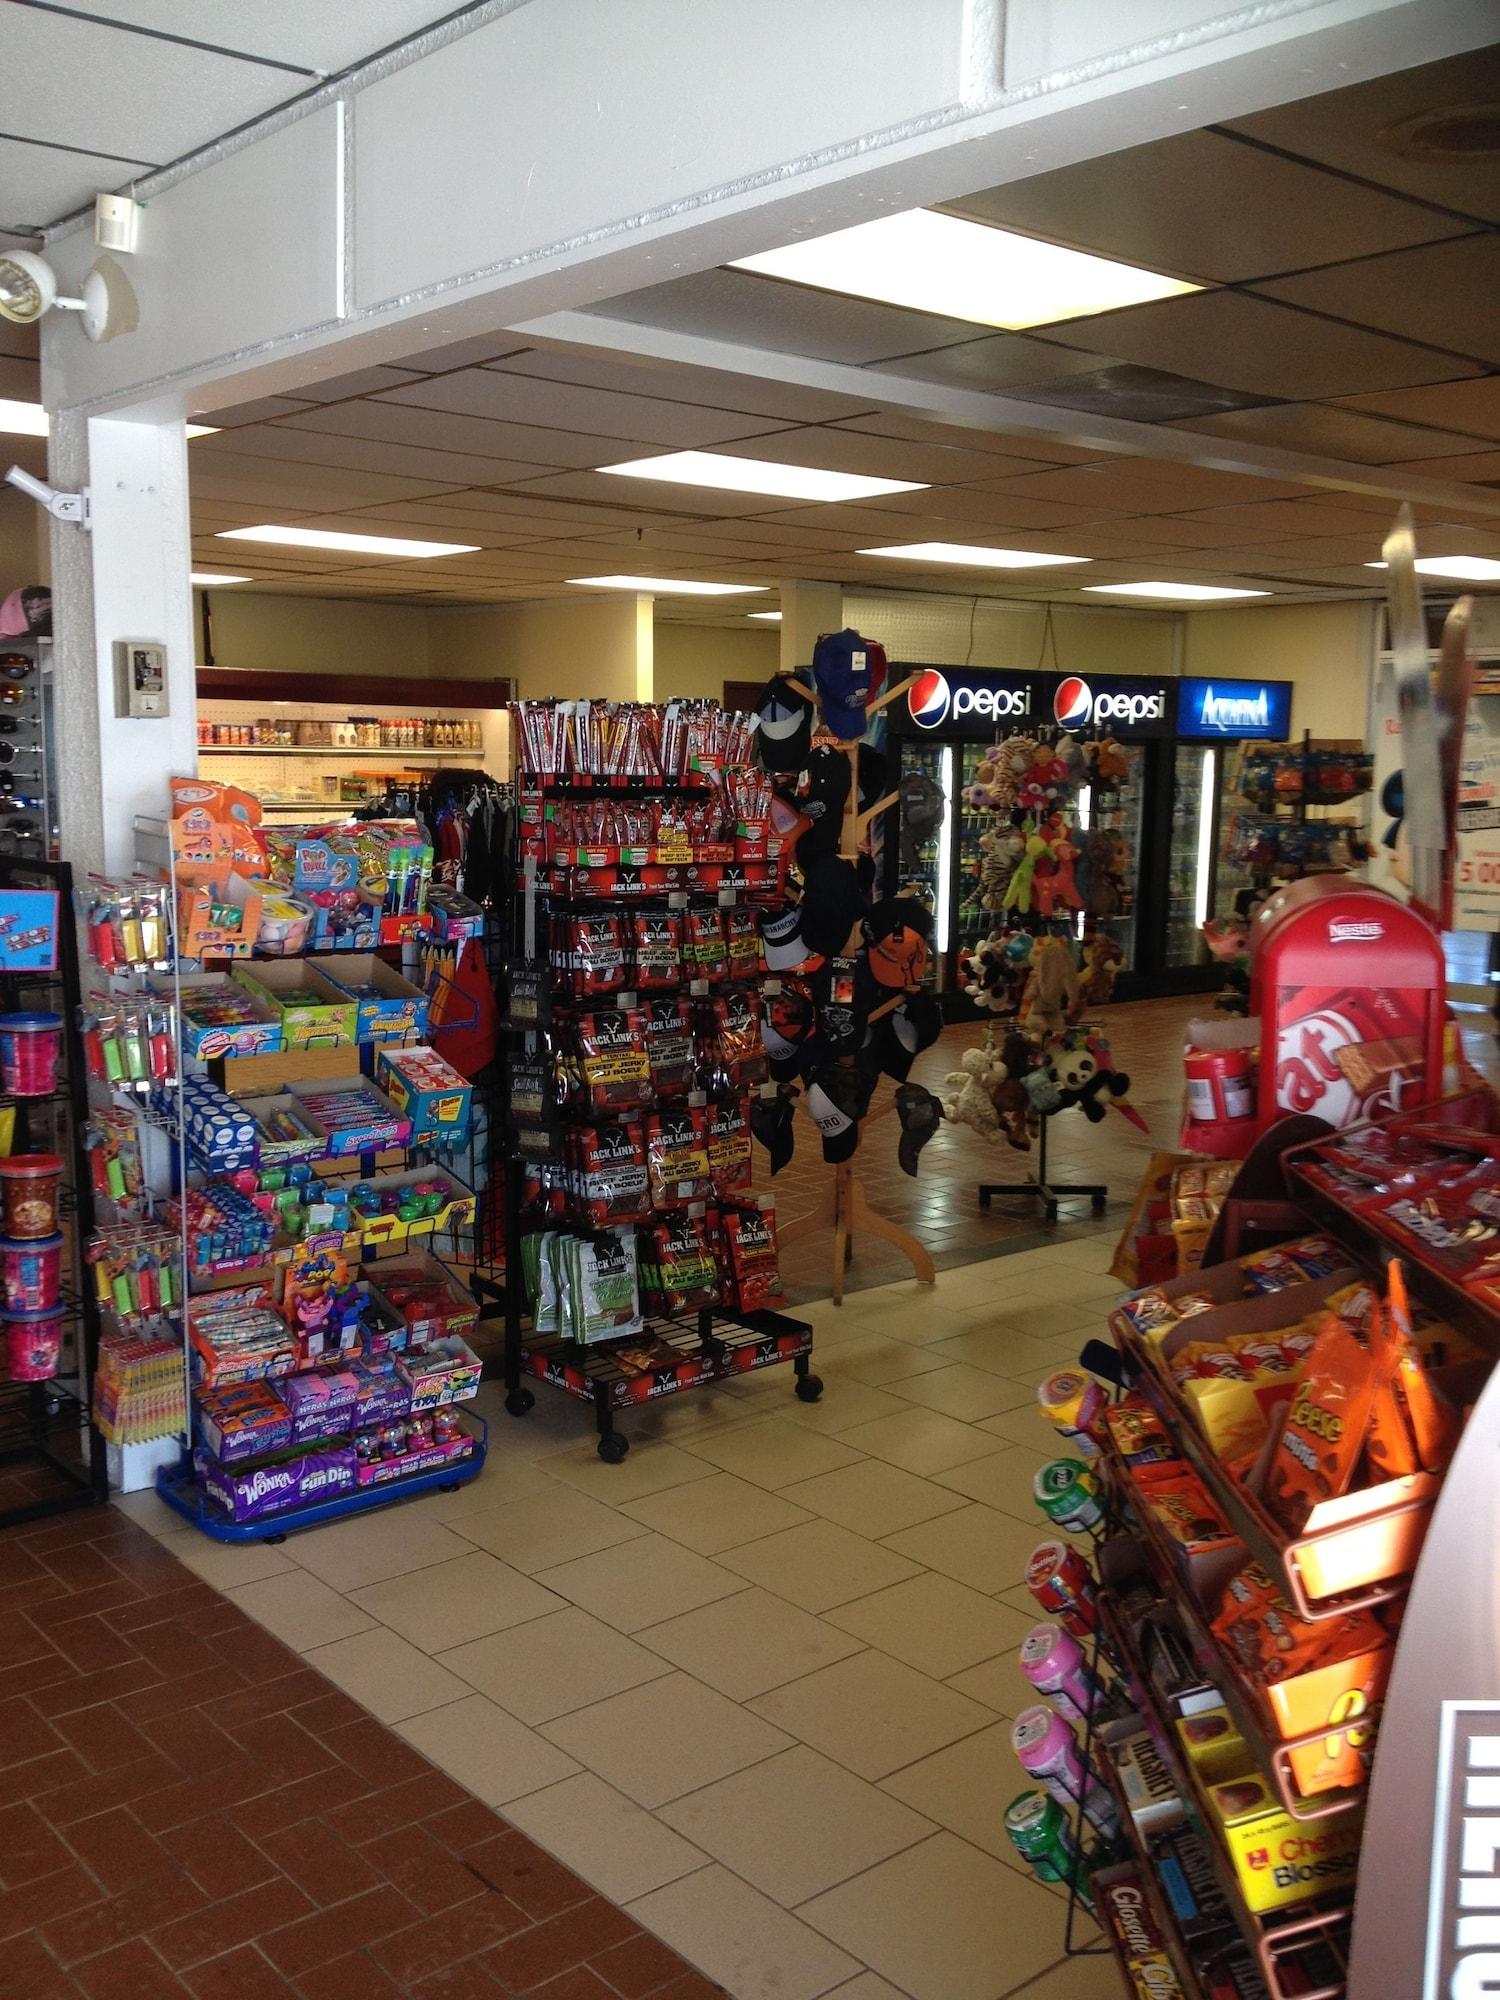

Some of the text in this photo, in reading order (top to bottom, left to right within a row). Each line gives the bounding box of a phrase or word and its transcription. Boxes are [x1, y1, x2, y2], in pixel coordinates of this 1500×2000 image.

[953, 685, 1031, 720] pepsi
[1093, 690, 1165, 725] pepsi
[302, 848, 327, 861] POP
[611, 883, 626, 891] JACK
[627, 883, 646, 891] LINK'S
[647, 1017, 686, 1031] ACK LINK'S
[589, 1032, 640, 1046] JACK LINK'S
[711, 1123, 727, 1134] JACK
[652, 1131, 702, 1145] JACK LINK'S
[590, 1144, 642, 1160] JACK LINK'S
[736, 1234, 754, 1244] JACK
[663, 1241, 684, 1252] JACK
[587, 1260, 610, 1272] JACK
[647, 1380, 682, 1396] JACK LINK'S
[238, 1466, 351, 1506] WONKA Fun Dip
[1111, 1885, 1150, 1954] Glosette
